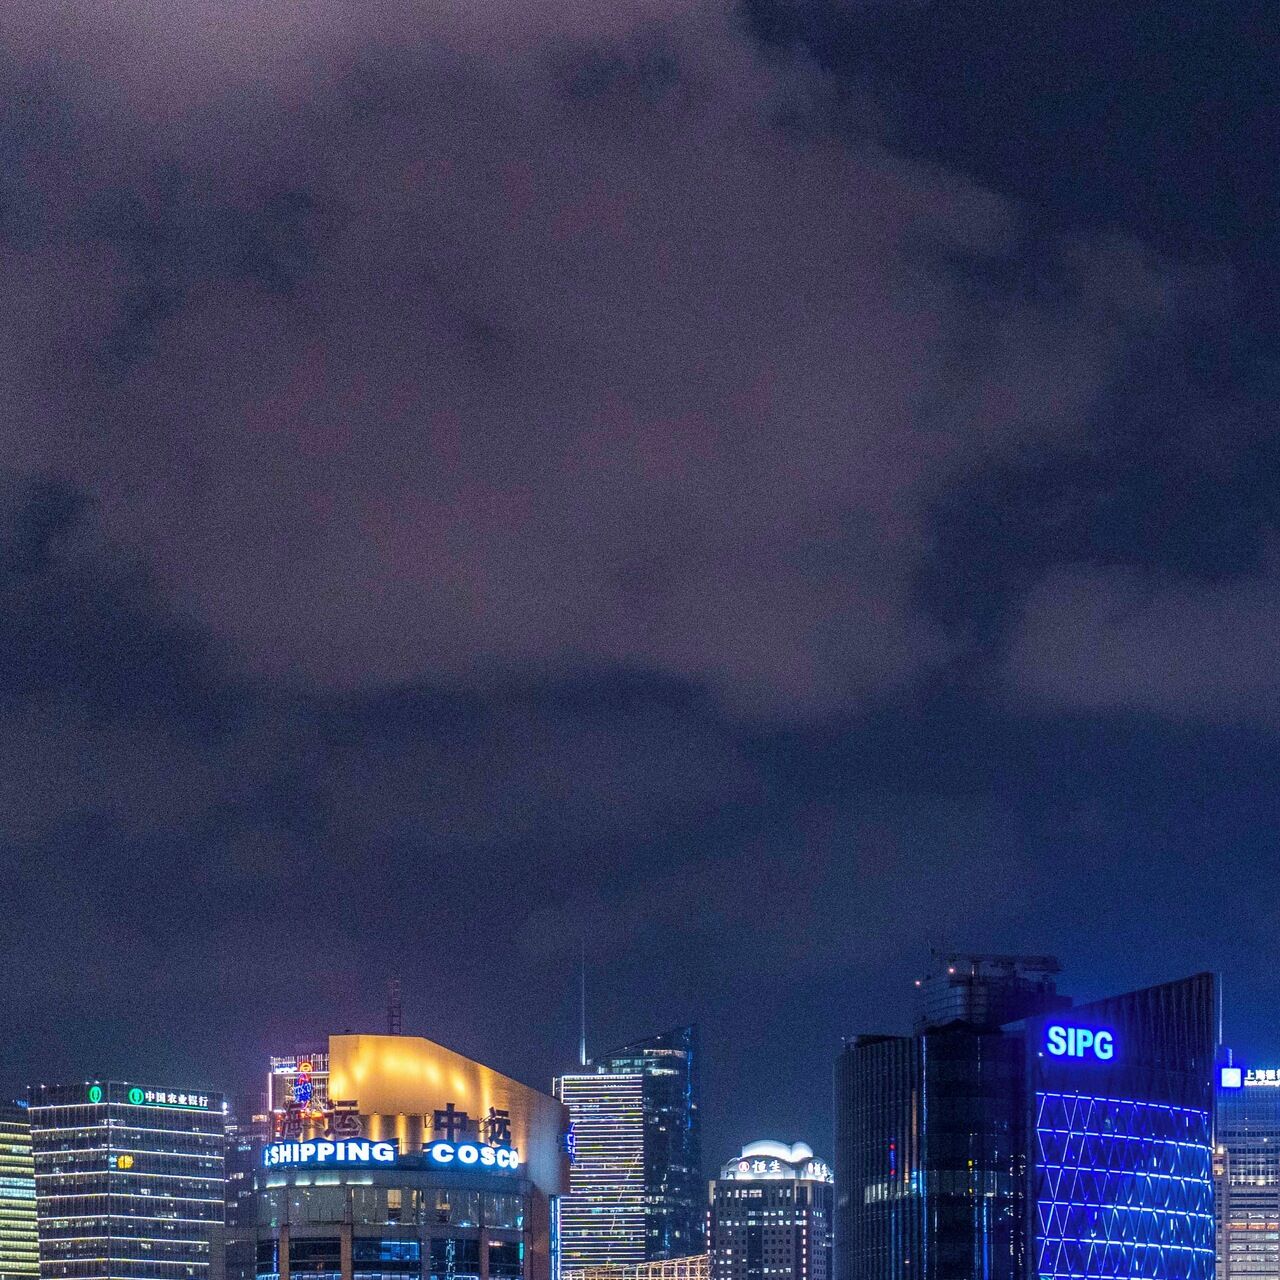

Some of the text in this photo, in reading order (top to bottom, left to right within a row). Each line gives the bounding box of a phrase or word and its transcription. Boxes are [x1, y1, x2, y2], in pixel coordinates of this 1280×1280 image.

[1046, 1025, 1114, 1060] SIPG
[145, 1090, 209, 1107] 中国农业银行
[270, 1142, 395, 1163] SHIPPING
[431, 1143, 519, 1169] COSCO
[752, 1160, 782, 1174] 恒生
